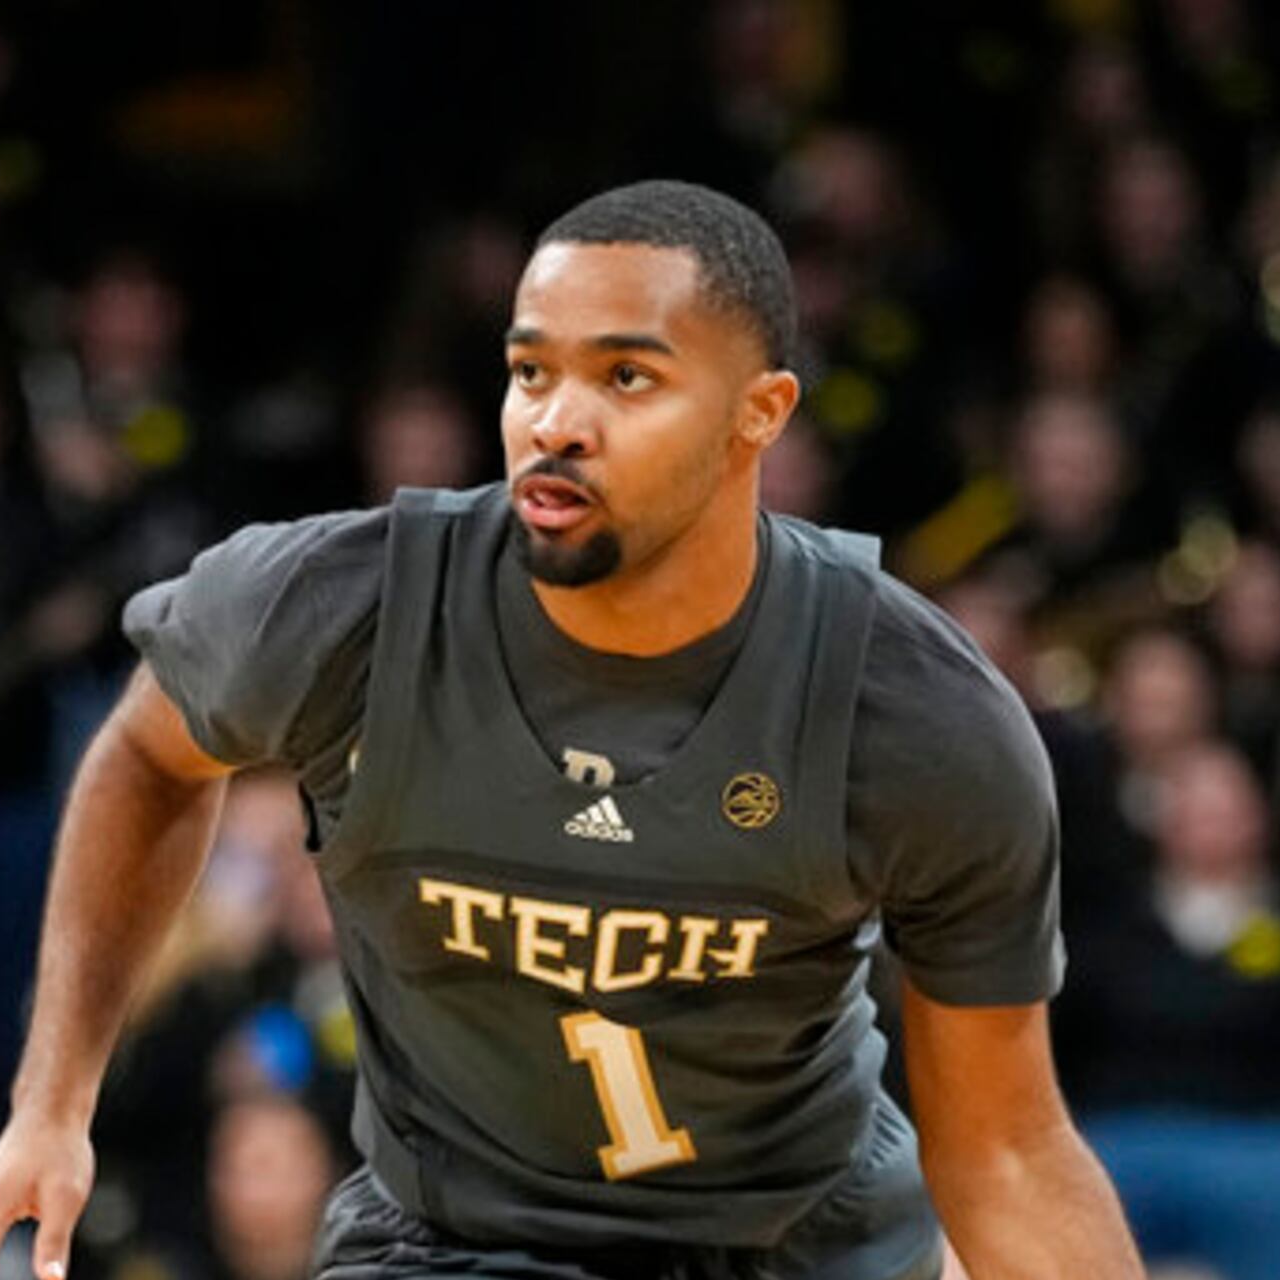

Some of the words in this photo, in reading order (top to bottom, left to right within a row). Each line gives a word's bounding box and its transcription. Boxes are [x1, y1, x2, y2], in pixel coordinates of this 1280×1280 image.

[564, 820, 634, 843] adidas
[419, 877, 770, 994] TECH
[559, 1009, 698, 1182] 1
